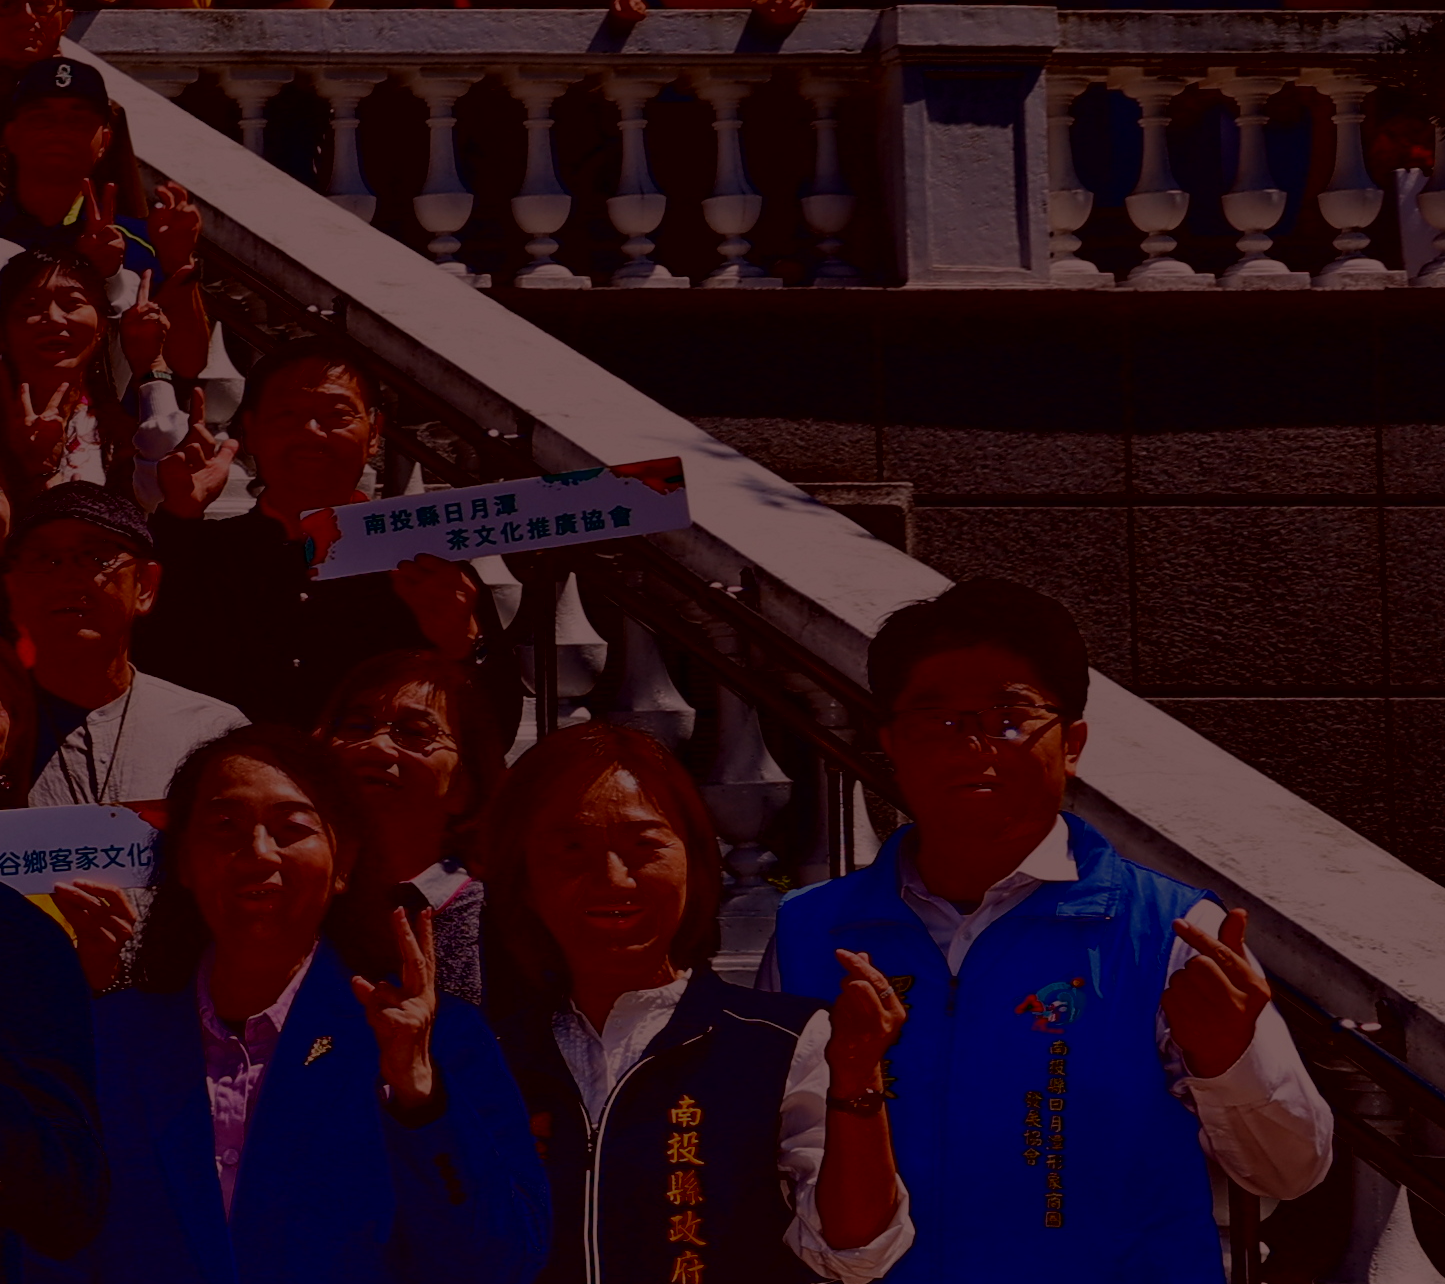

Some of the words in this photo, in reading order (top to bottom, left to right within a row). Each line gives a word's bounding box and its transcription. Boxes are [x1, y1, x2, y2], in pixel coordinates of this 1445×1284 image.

[362, 492, 520, 537] 南投縣日月潭
[444, 504, 634, 551] 茶文化推廣協會
[1022, 1090, 1044, 1167] 發展協會
[1043, 1039, 1070, 1229] 南投縣日月潭形象商圈
